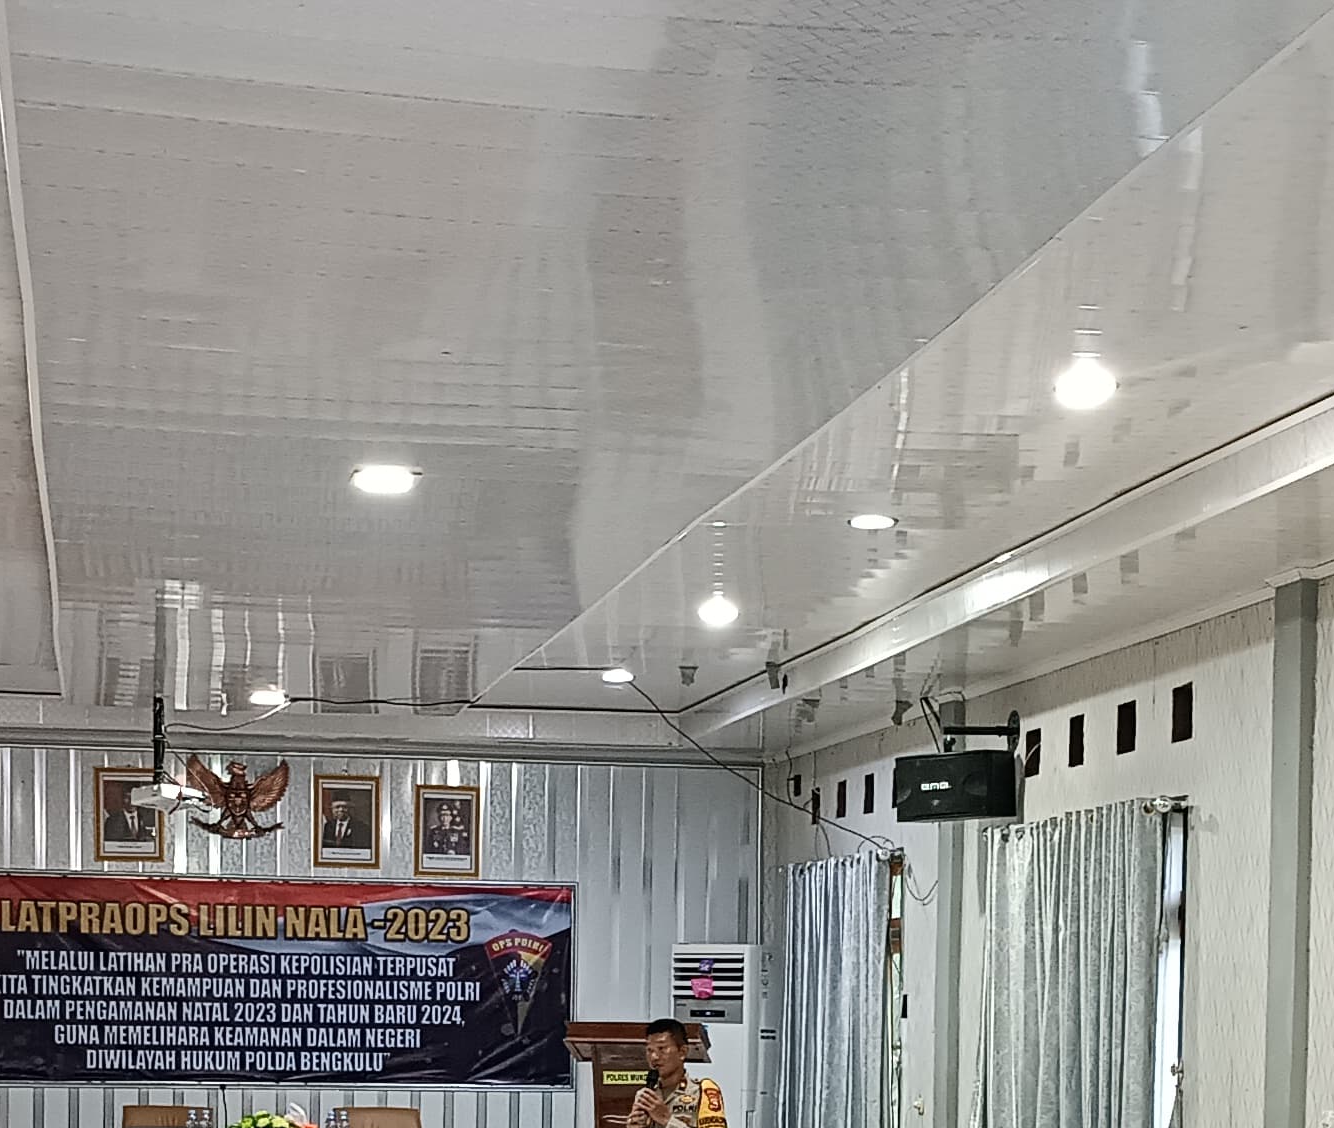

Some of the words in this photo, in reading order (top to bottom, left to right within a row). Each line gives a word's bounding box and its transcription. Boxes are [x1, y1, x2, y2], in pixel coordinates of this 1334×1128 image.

[0, 899, 190, 936] LATPRAOPS
[199, 903, 278, 938] LILIN
[285, 906, 366, 939] NALA
[373, 907, 469, 942] -2023
[492, 938, 513, 952] OPS
[514, 937, 548, 952] POLRI
[17, 949, 95, 971] "MELALUI
[99, 951, 166, 973] LATIHAN
[171, 952, 203, 973] PRA
[208, 953, 276, 975] OPERASI
[281, 955, 376, 976] KEPOLISIAN
[377, 956, 457, 977] TERPUSAT
[32, 975, 136, 996] TINGKATKAN
[141, 977, 245, 998] KEMAMPUAN
[250, 979, 282, 999] DAN
[287, 979, 432, 1001] PROFESIONALISME
[436, 981, 481, 1002] POLRI
[3, 999, 60, 1020] DALAM
[65, 1000, 177, 1021] PENGAMANAN
[182, 1001, 230, 1022] NATAL
[234, 1002, 277, 1023] 2023
[281, 1003, 313, 1024] DAN
[317, 1004, 370, 1025] TAHUN
[374, 1004, 417, 1025] BARU
[421, 1005, 465, 1027] 2024,
[54, 1024, 99, 1045] GUNA
[104, 1025, 210, 1046] MEMELIHARA
[214, 1026, 302, 1047] KEAMANAN
[307, 1027, 361, 1048] DALAM
[365, 1028, 421, 1049] NEGERI
[86, 1049, 175, 1070] DIWILAYAH
[180, 1050, 241, 1071] HUKUM
[245, 1051, 296, 1071] POLDA
[606, 1073, 628, 1082] POLRES
